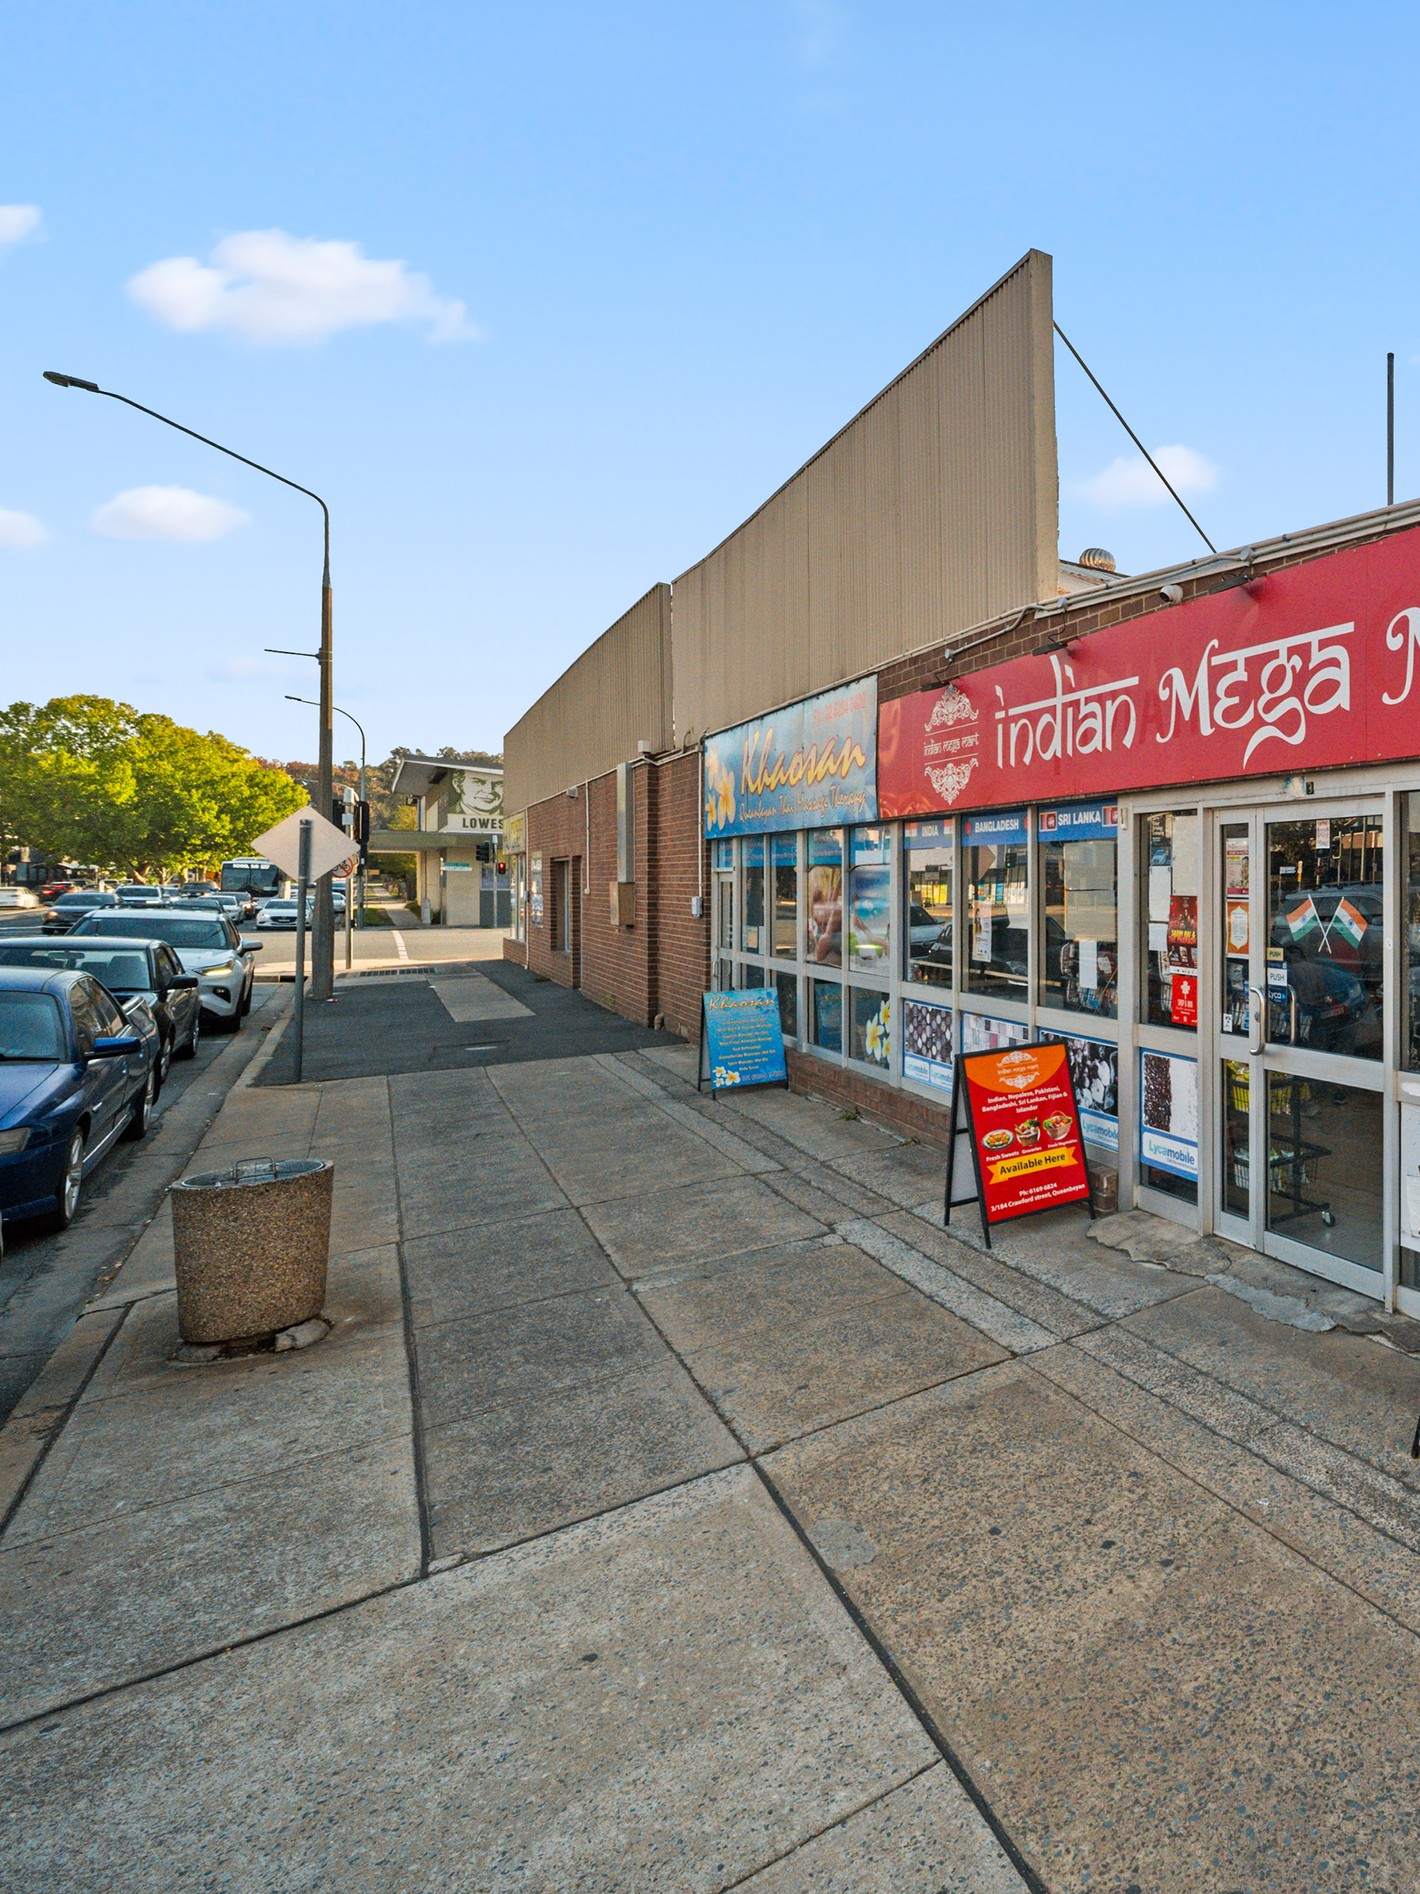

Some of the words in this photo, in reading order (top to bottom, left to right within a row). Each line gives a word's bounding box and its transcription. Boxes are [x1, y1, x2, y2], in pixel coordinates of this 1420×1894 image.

[995, 655, 1139, 769] indian
[740, 727, 866, 796] Khaosan
[830, 785, 866, 812] Therapy
[462, 817, 504, 830] LOWES
[1058, 813, 1072, 826] SRI
[1073, 811, 1101, 825] LANKA
[922, 825, 938, 837] INDIA
[975, 819, 1019, 833] BANGLADESH
[1269, 973, 1285, 981] PUSH
[1268, 990, 1281, 1000] Lyca
[709, 996, 776, 1010] Khaosan
[988, 1095, 1007, 1104] Indian,
[1008, 1091, 1034, 1100] Nepalese,
[1034, 1086, 1060, 1095] Pakistani,
[982, 1101, 1018, 1112] Bangladeshi,
[1027, 1096, 1048, 1104] Lankan,
[1016, 1105, 1038, 1113] Islander
[1001, 1151, 1020, 1159] Sweets
[1022, 1146, 1042, 1154] Groceries
[1149, 1140, 1195, 1165] Lycamobile
[1000, 1159, 1043, 1174] Available
[1044, 1154, 1066, 1165] Here
[1008, 1197, 1034, 1208] Crawford
[1052, 1183, 1086, 1197] Queanbeyan
